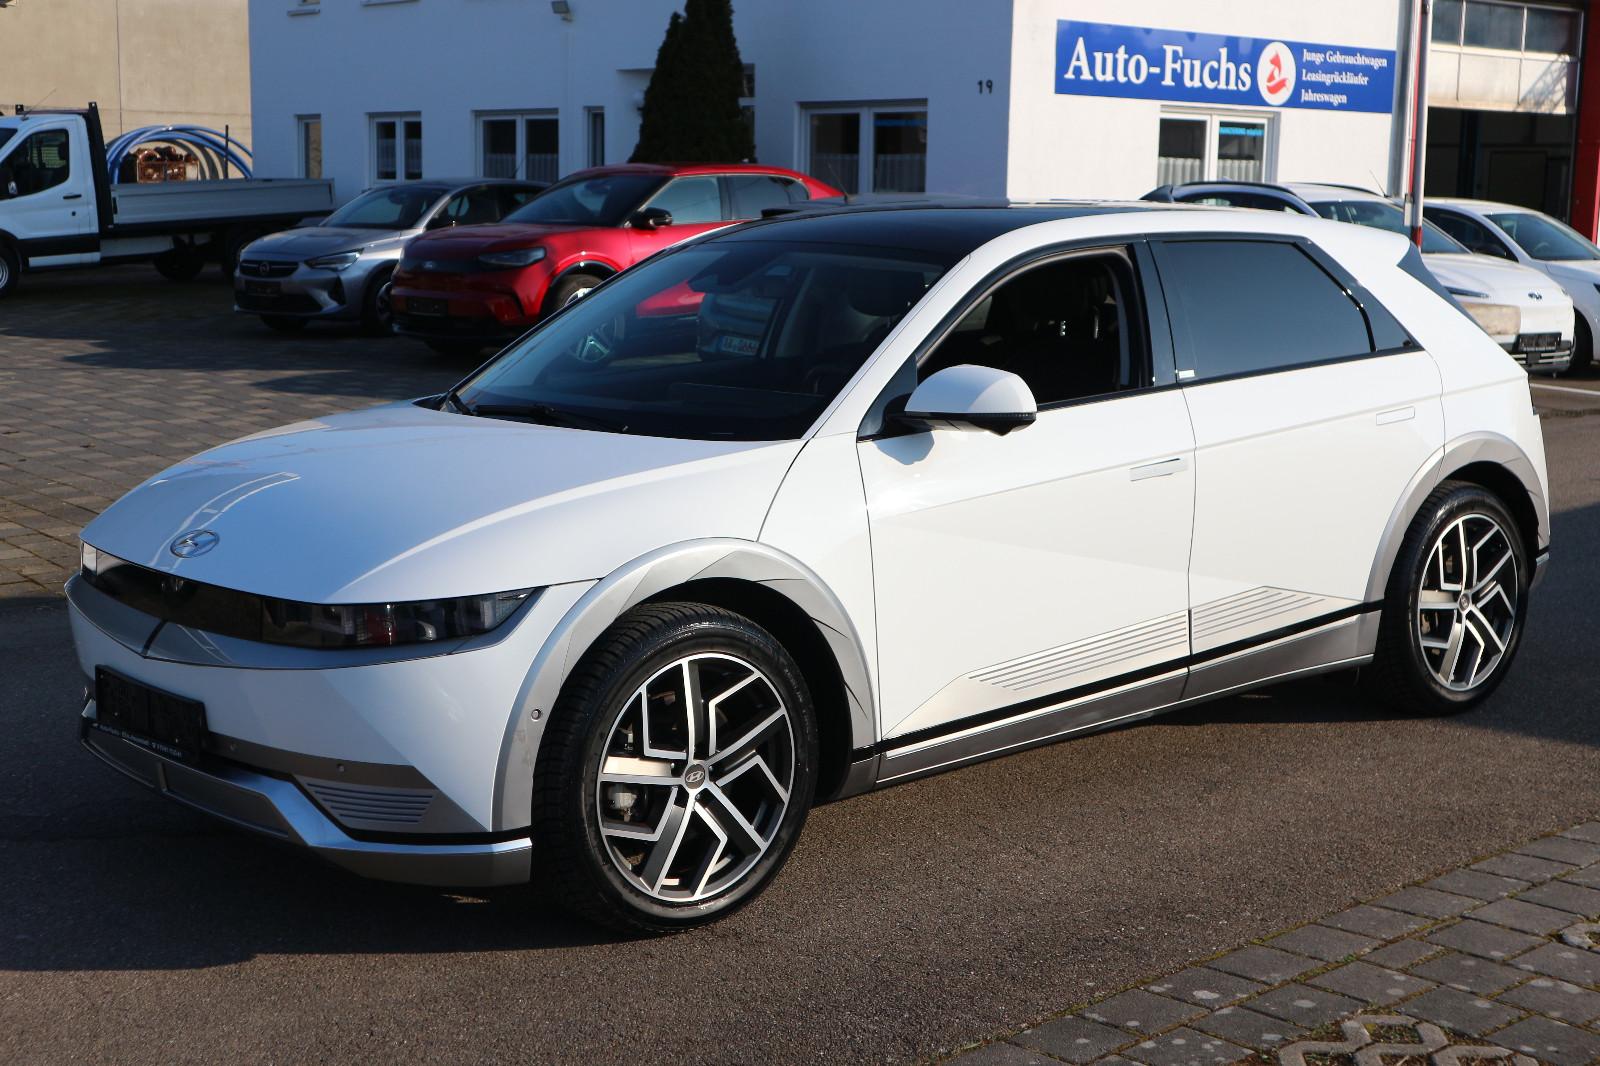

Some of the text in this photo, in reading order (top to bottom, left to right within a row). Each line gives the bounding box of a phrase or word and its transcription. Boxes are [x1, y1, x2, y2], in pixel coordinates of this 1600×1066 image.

[1063, 36, 1252, 92] Auto-Fuchs
[1302, 48, 1388, 70] Junge Gebrauchtwagen
[977, 79, 993, 95] 19
[1300, 88, 1348, 107] Jahreswagen
